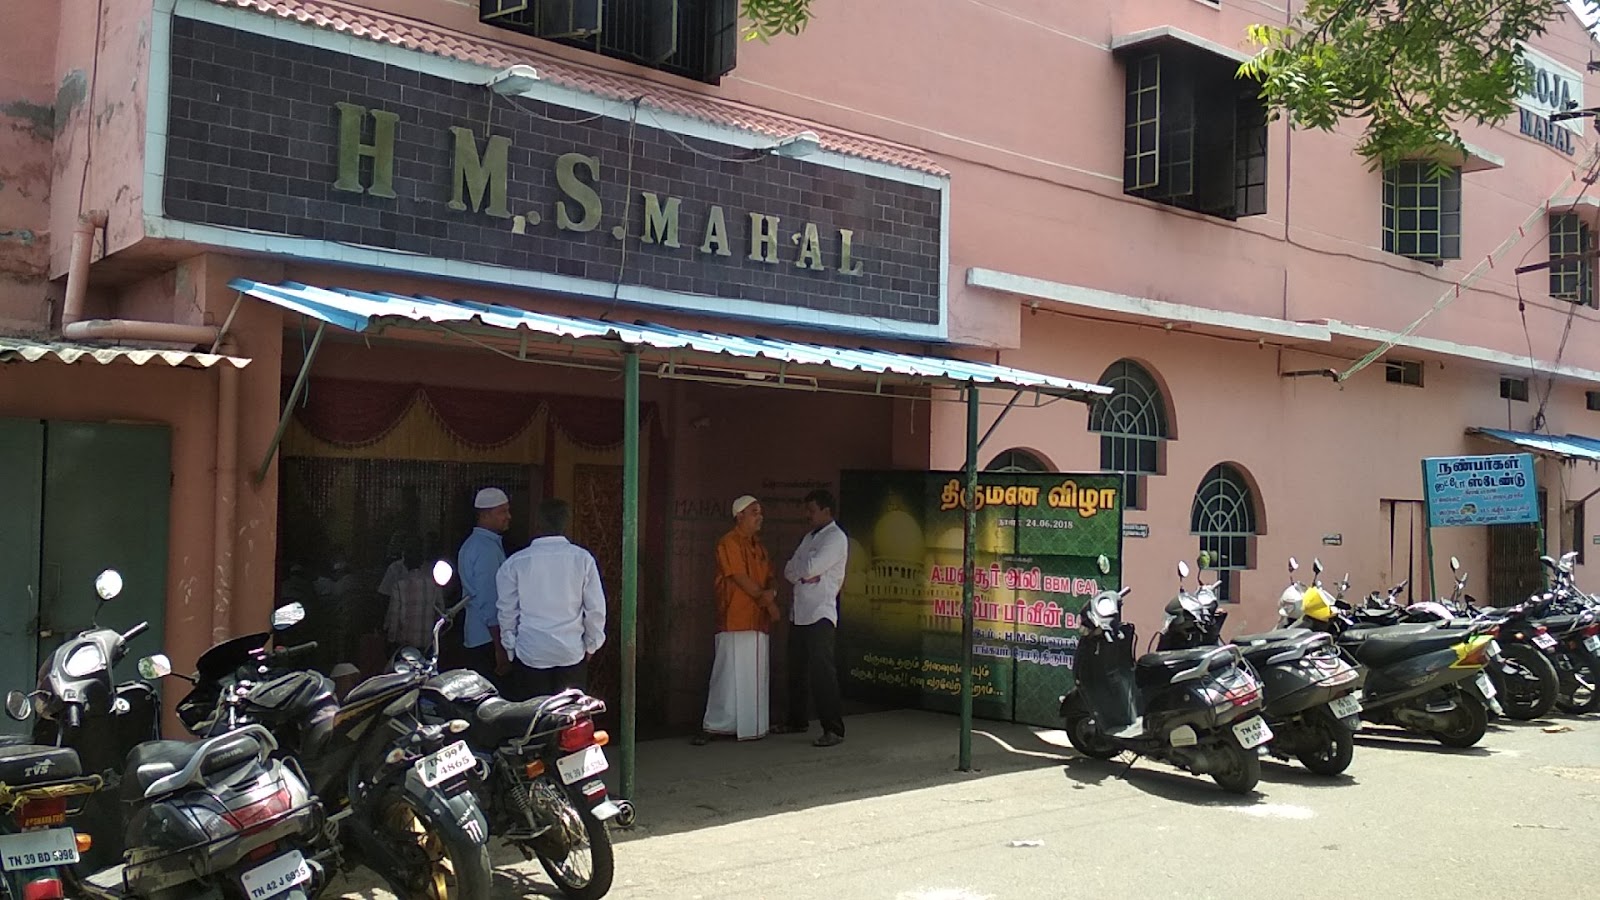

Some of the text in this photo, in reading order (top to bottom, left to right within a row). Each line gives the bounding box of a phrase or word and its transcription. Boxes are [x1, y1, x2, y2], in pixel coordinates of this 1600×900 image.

[1520, 107, 1575, 156] MAHAL
[641, 191, 864, 277] MAHAL
[1437, 455, 1519, 477] நண்பர்கள்
[1048, 480, 1116, 516] விழா
[1025, 518, 1074, 529] 24.06.2018
[1004, 565, 1042, 591] அலி
[1044, 576, 1071, 593] BBM
[1003, 597, 1063, 628] பர்வீன்
[1240, 726, 1252, 736] TN
[445, 748, 458, 759] 99
[24, 765, 49, 777] TVS
[440, 756, 470, 774] 4865
[8, 856, 22, 867] TN
[24, 854, 36, 865] 39
[38, 852, 50, 862] BD
[251, 886, 265, 899] TN
[266, 880, 278, 891] 42
[279, 875, 284, 886] J
